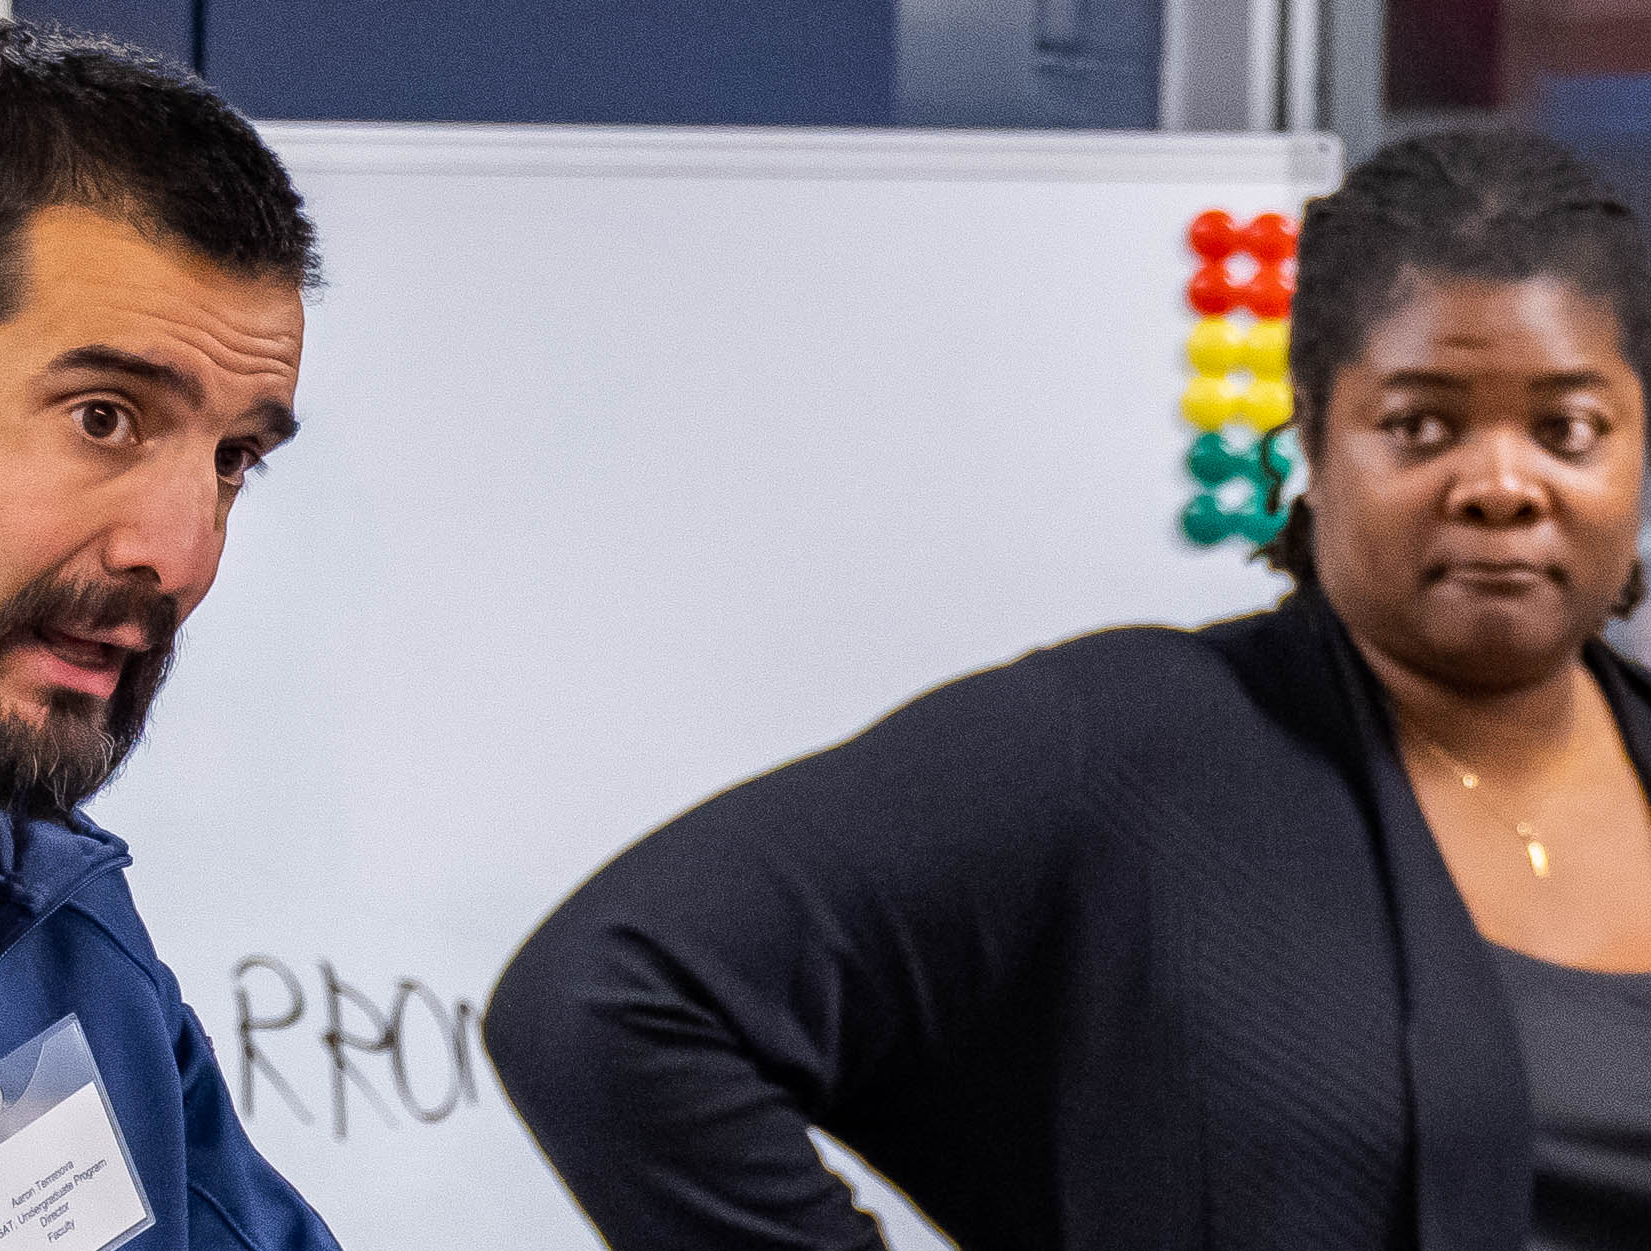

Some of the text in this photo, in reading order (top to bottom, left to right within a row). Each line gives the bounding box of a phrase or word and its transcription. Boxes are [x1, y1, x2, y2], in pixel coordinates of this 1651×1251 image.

[11, 1187, 36, 1208] Aaron
[17, 1181, 74, 1226] Undergraduate
[73, 1158, 108, 1186] Program
[39, 1202, 70, 1228] Director
[47, 1218, 76, 1243] Faculty
